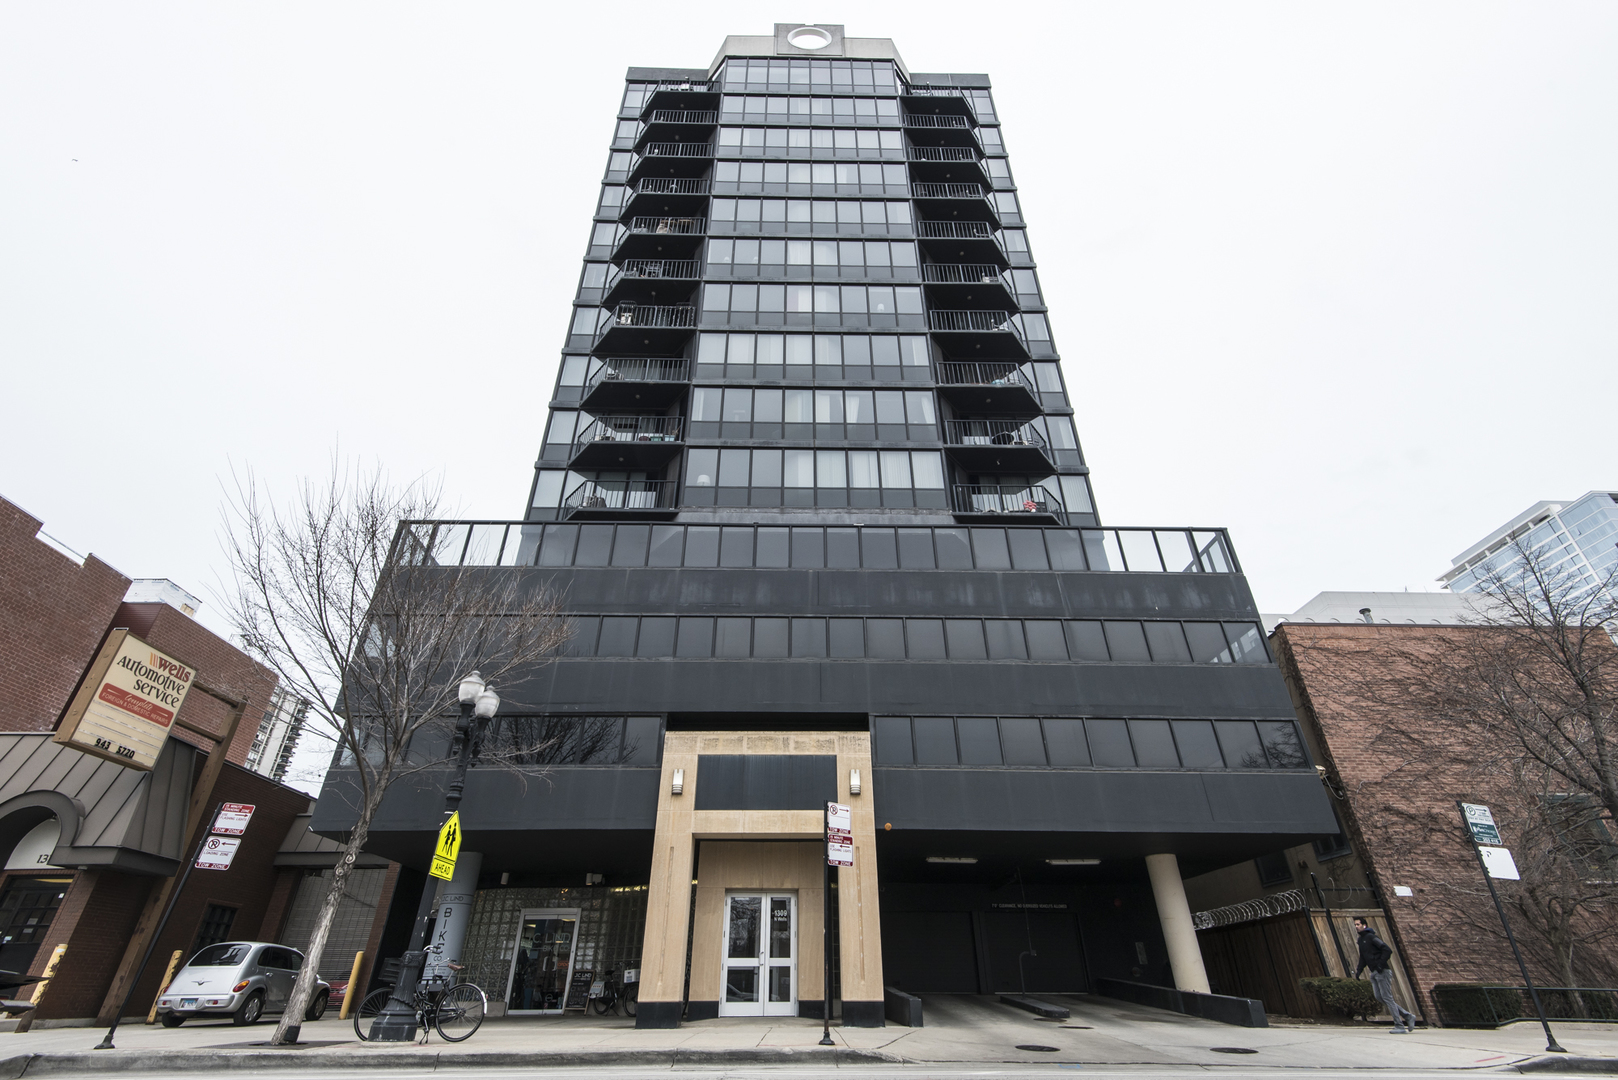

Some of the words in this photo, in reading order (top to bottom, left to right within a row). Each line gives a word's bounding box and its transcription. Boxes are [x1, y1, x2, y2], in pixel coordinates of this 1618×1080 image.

[133, 679, 180, 708] service
[101, 692, 124, 706] FOREIGN
[127, 702, 149, 717] DOMESTIC
[150, 712, 169, 725] REPAIRS
[95, 738, 111, 750] 943
[116, 745, 136, 759] 5720
[36, 854, 50, 864] 13
[434, 862, 450, 876] AHEAD
[437, 907, 453, 954] BIKE
[544, 932, 571, 944] LIND
